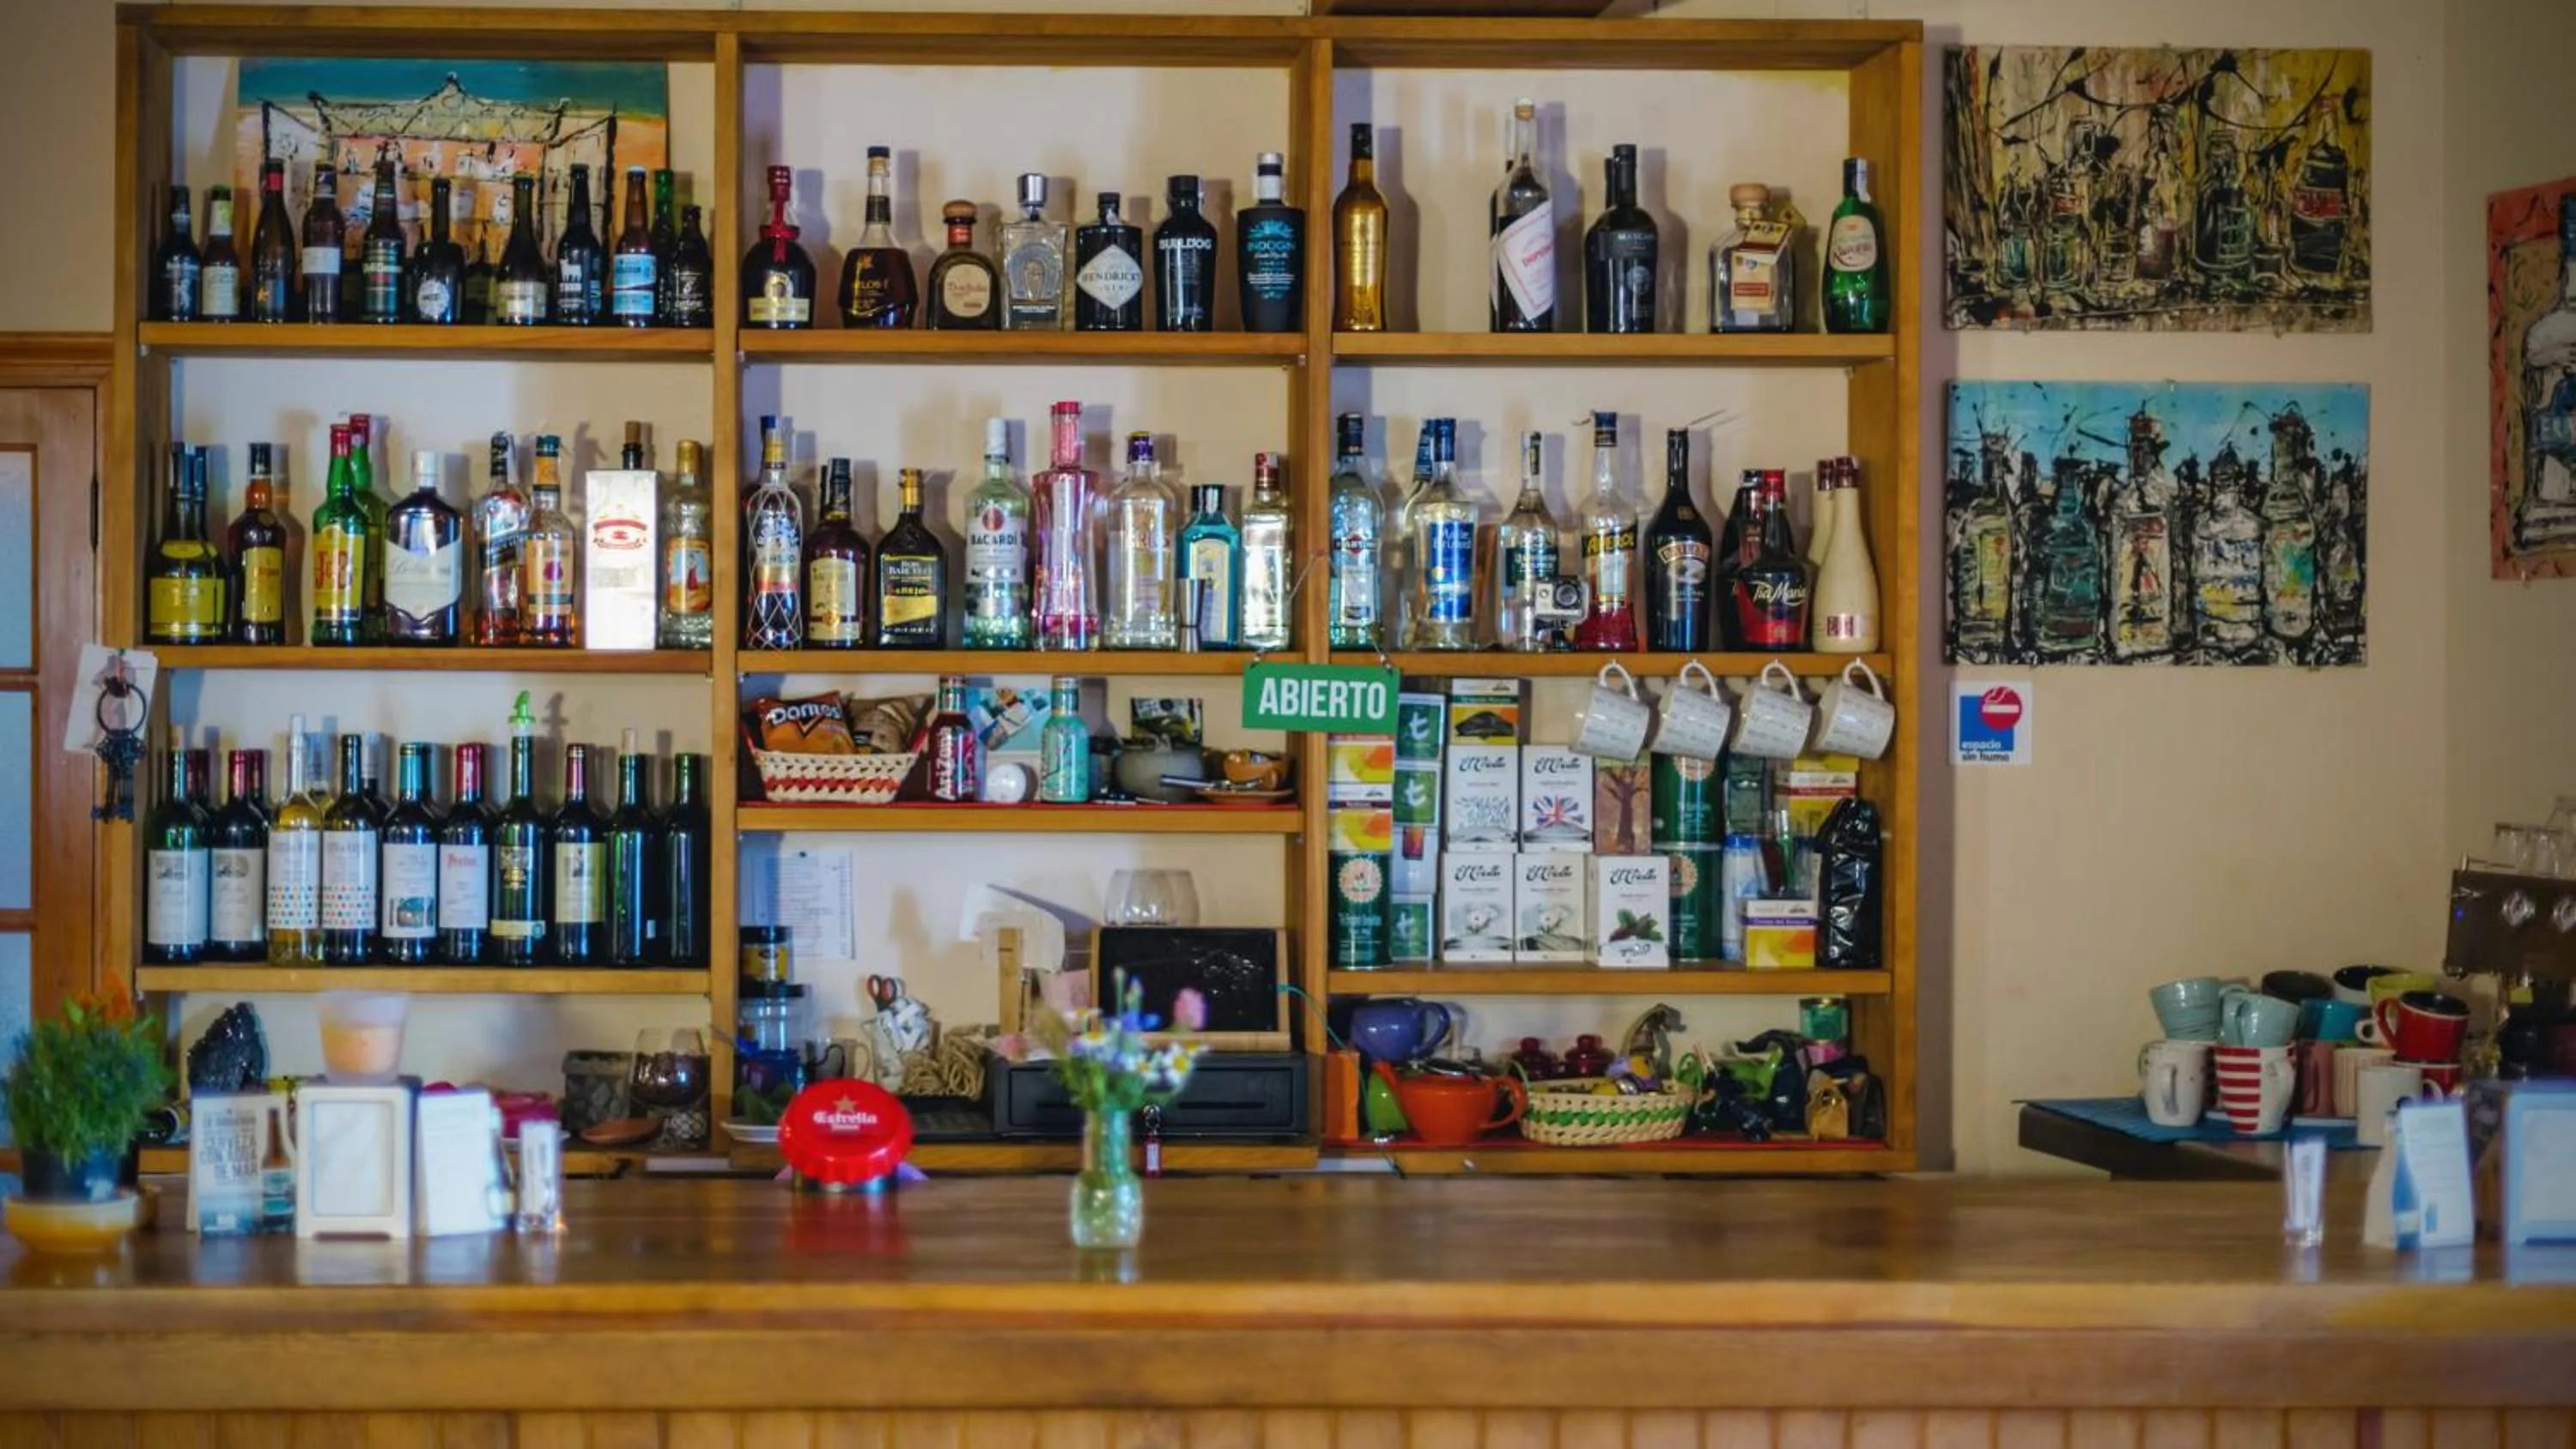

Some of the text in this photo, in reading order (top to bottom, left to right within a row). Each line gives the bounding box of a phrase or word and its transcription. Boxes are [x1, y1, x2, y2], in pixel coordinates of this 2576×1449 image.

[1158, 238, 1212, 250] BULLDOG
[314, 549, 352, 591] J&B
[1258, 677, 1386, 719] ABIERTO
[1961, 739, 2002, 752] espacio
[1962, 750, 2010, 762] sin humo
[812, 1111, 878, 1125] Estrella
